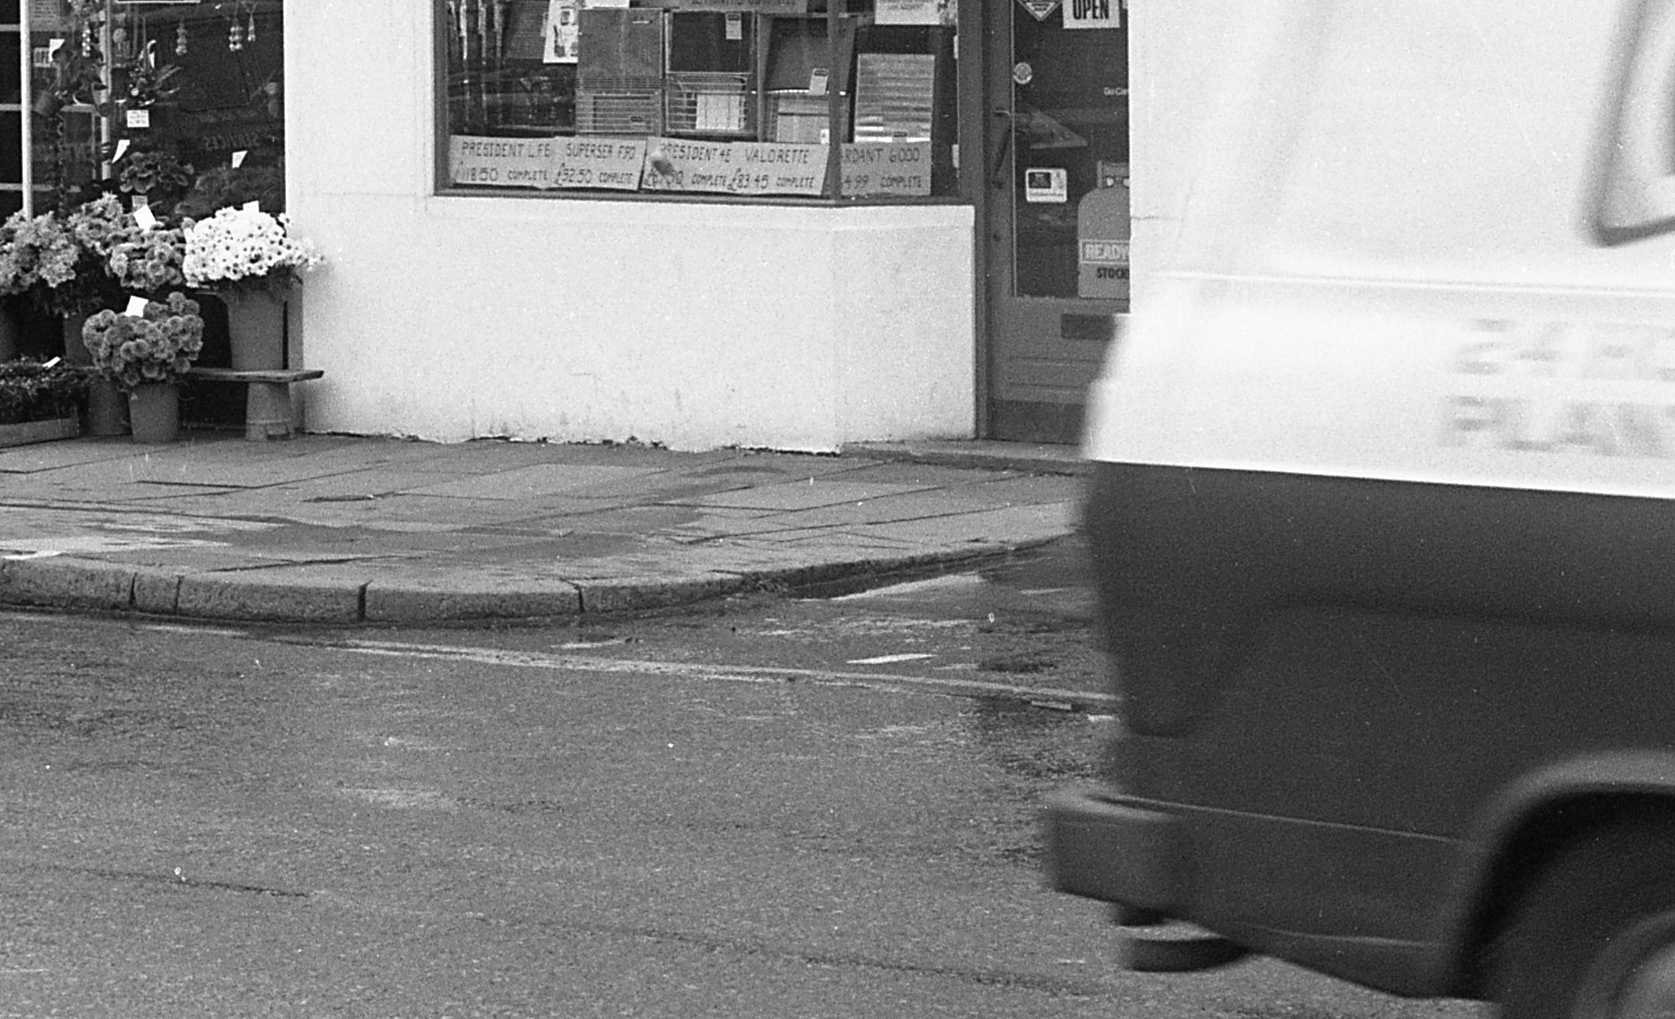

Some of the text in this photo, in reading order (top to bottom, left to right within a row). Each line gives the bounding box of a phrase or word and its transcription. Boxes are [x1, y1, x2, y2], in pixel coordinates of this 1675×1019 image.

[462, 142, 525, 158] PRESIDENT
[744, 148, 809, 164] VALORETTE
[507, 169, 549, 181] COMPLETE
